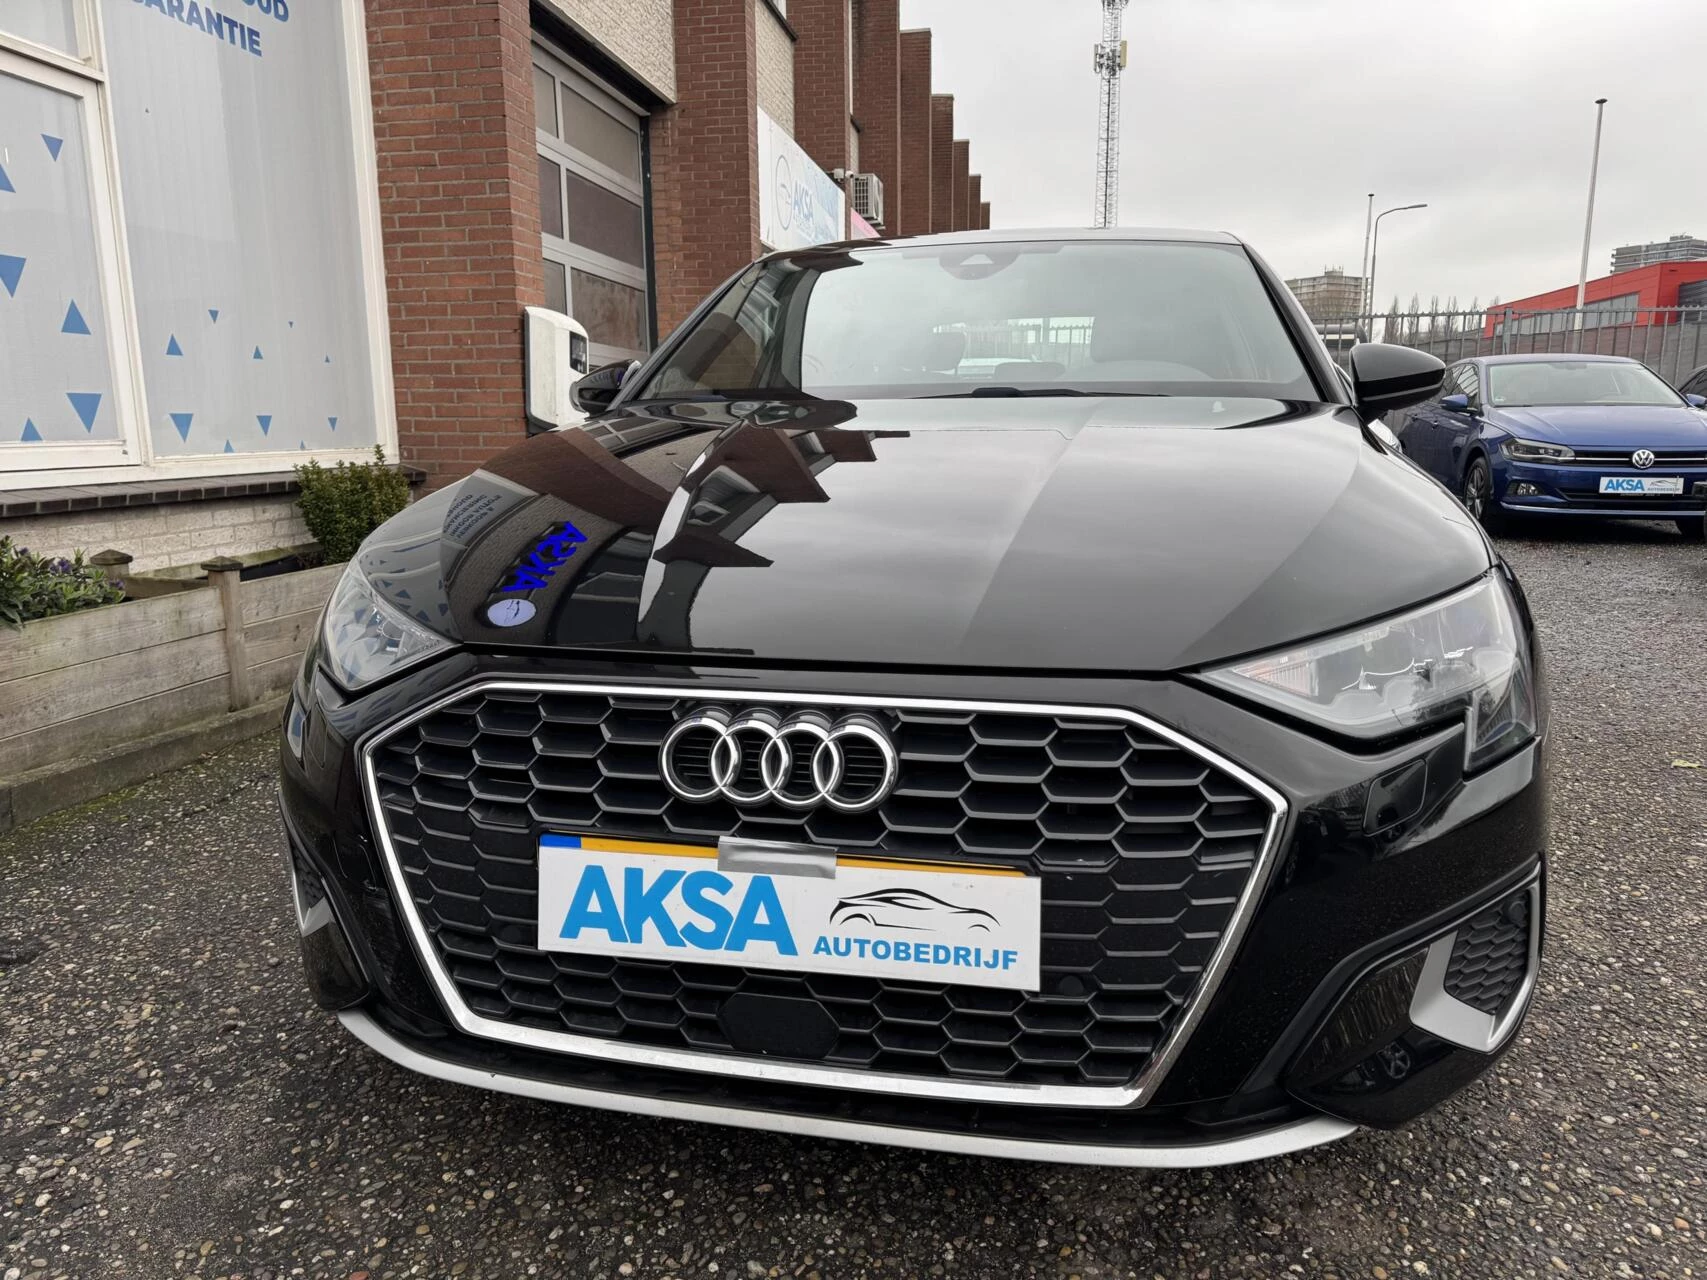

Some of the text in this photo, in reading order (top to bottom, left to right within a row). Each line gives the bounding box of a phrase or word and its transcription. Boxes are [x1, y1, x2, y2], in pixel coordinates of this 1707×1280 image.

[1604, 478, 1645, 491] AKSA
[558, 864, 799, 956] AKSA
[812, 935, 1019, 971] AUTOBEDRIJF
